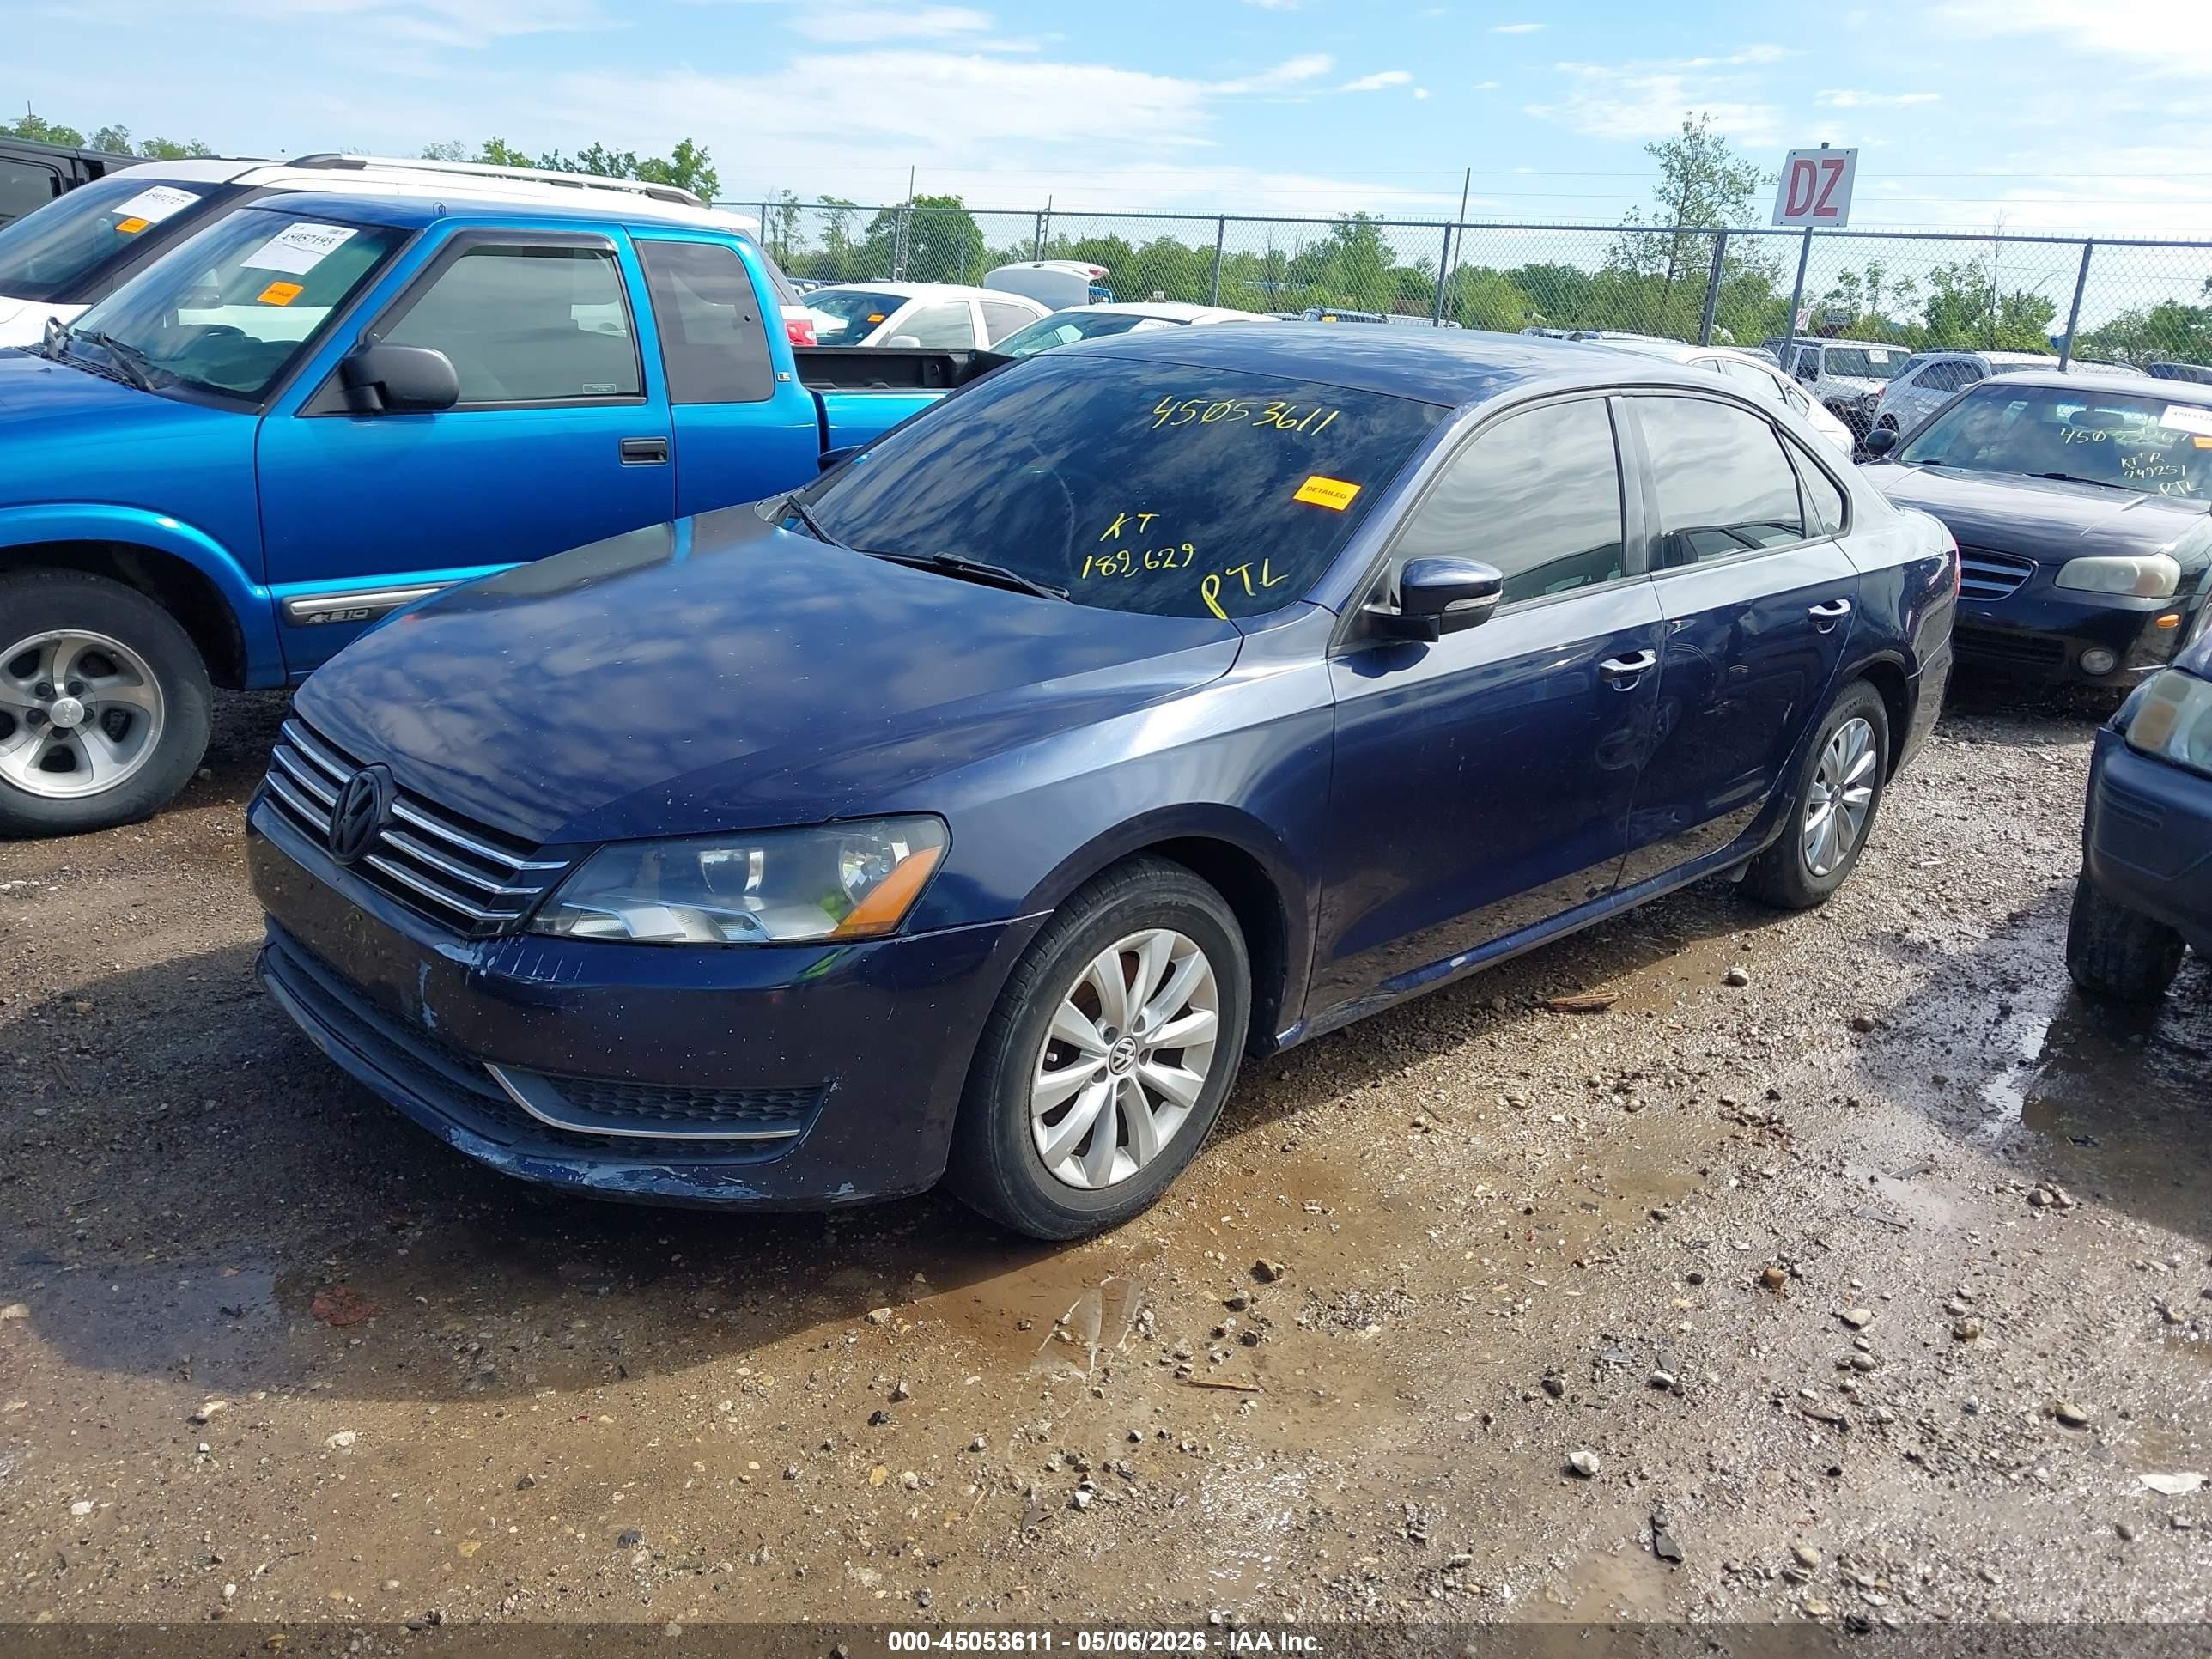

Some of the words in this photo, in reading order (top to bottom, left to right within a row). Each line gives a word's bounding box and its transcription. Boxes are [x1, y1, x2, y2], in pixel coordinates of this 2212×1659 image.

[1784, 159, 1845, 216] DZ
[777, 373, 791, 381] LS
[1151, 395, 1340, 436] 45053611
[1304, 485, 1348, 500] DETAILED
[1098, 512, 1161, 542] KT
[1081, 542, 1197, 579] 189,629
[1201, 557, 1289, 621] PTL
[330, 608, 369, 621] S10
